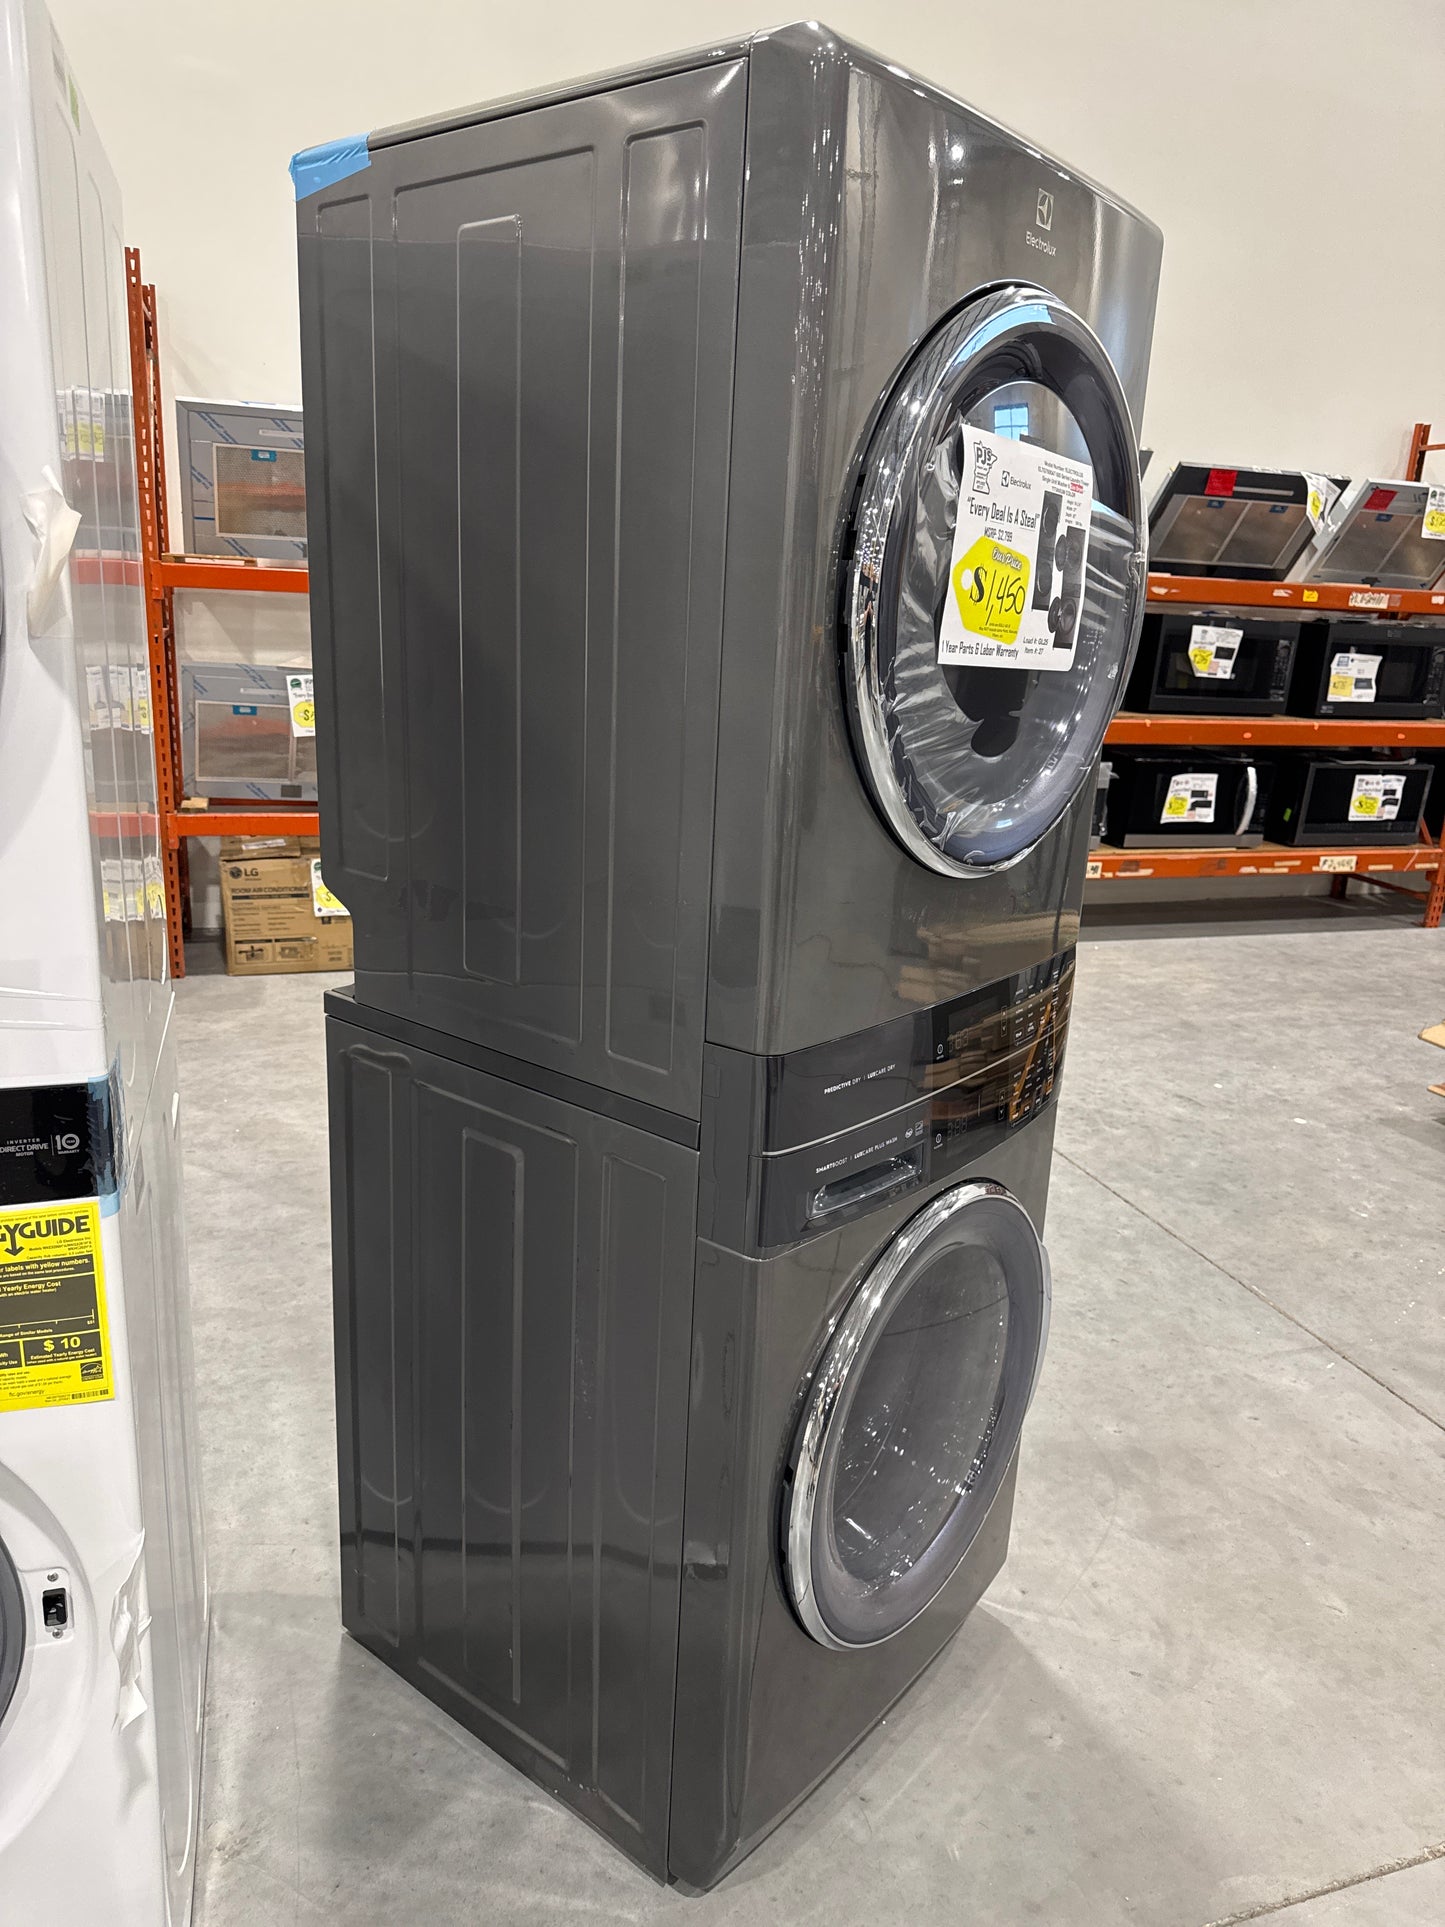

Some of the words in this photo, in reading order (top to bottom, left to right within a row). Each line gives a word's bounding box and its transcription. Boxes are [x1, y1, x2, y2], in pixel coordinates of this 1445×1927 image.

[1026, 230, 1056, 256] Electrolux
[1010, 476, 1032, 490] Electrolux
[991, 502, 1005, 520] Deal
[1007, 506, 1012, 523] Is
[1014, 508, 1019, 523] A
[992, 546, 1005, 561] Our
[1005, 554, 1022, 572] Price
[970, 564, 1025, 626] $1,450
[945, 641, 958, 654] Year
[959, 642, 974, 655] Parts
[980, 644, 995, 656] Labor
[996, 644, 1019, 660] Warranty
[244, 868, 258, 876] LG
[824, 1080, 851, 1094] PREDICTIVE
[852, 1077, 861, 1085] DRY
[887, 1064, 896, 1072] DRY
[0, 1144, 26, 1154] DIRECT
[26, 1143, 49, 1151] DRIVE
[56, 1133, 80, 1150] 10
[816, 1156, 848, 1174] SMARTBOOST
[874, 1142, 885, 1150] PLUS
[886, 1136, 898, 1145] WASH
[5, 1264, 24, 1272] labels
[40, 1261, 60, 1270] yellow
[62, 1258, 90, 1266] numbers.
[24, 1282, 45, 1290] Energy
[43, 1340, 55, 1352] $
[60, 1337, 81, 1349] 10
[30, 1352, 52, 1360] Estimated
